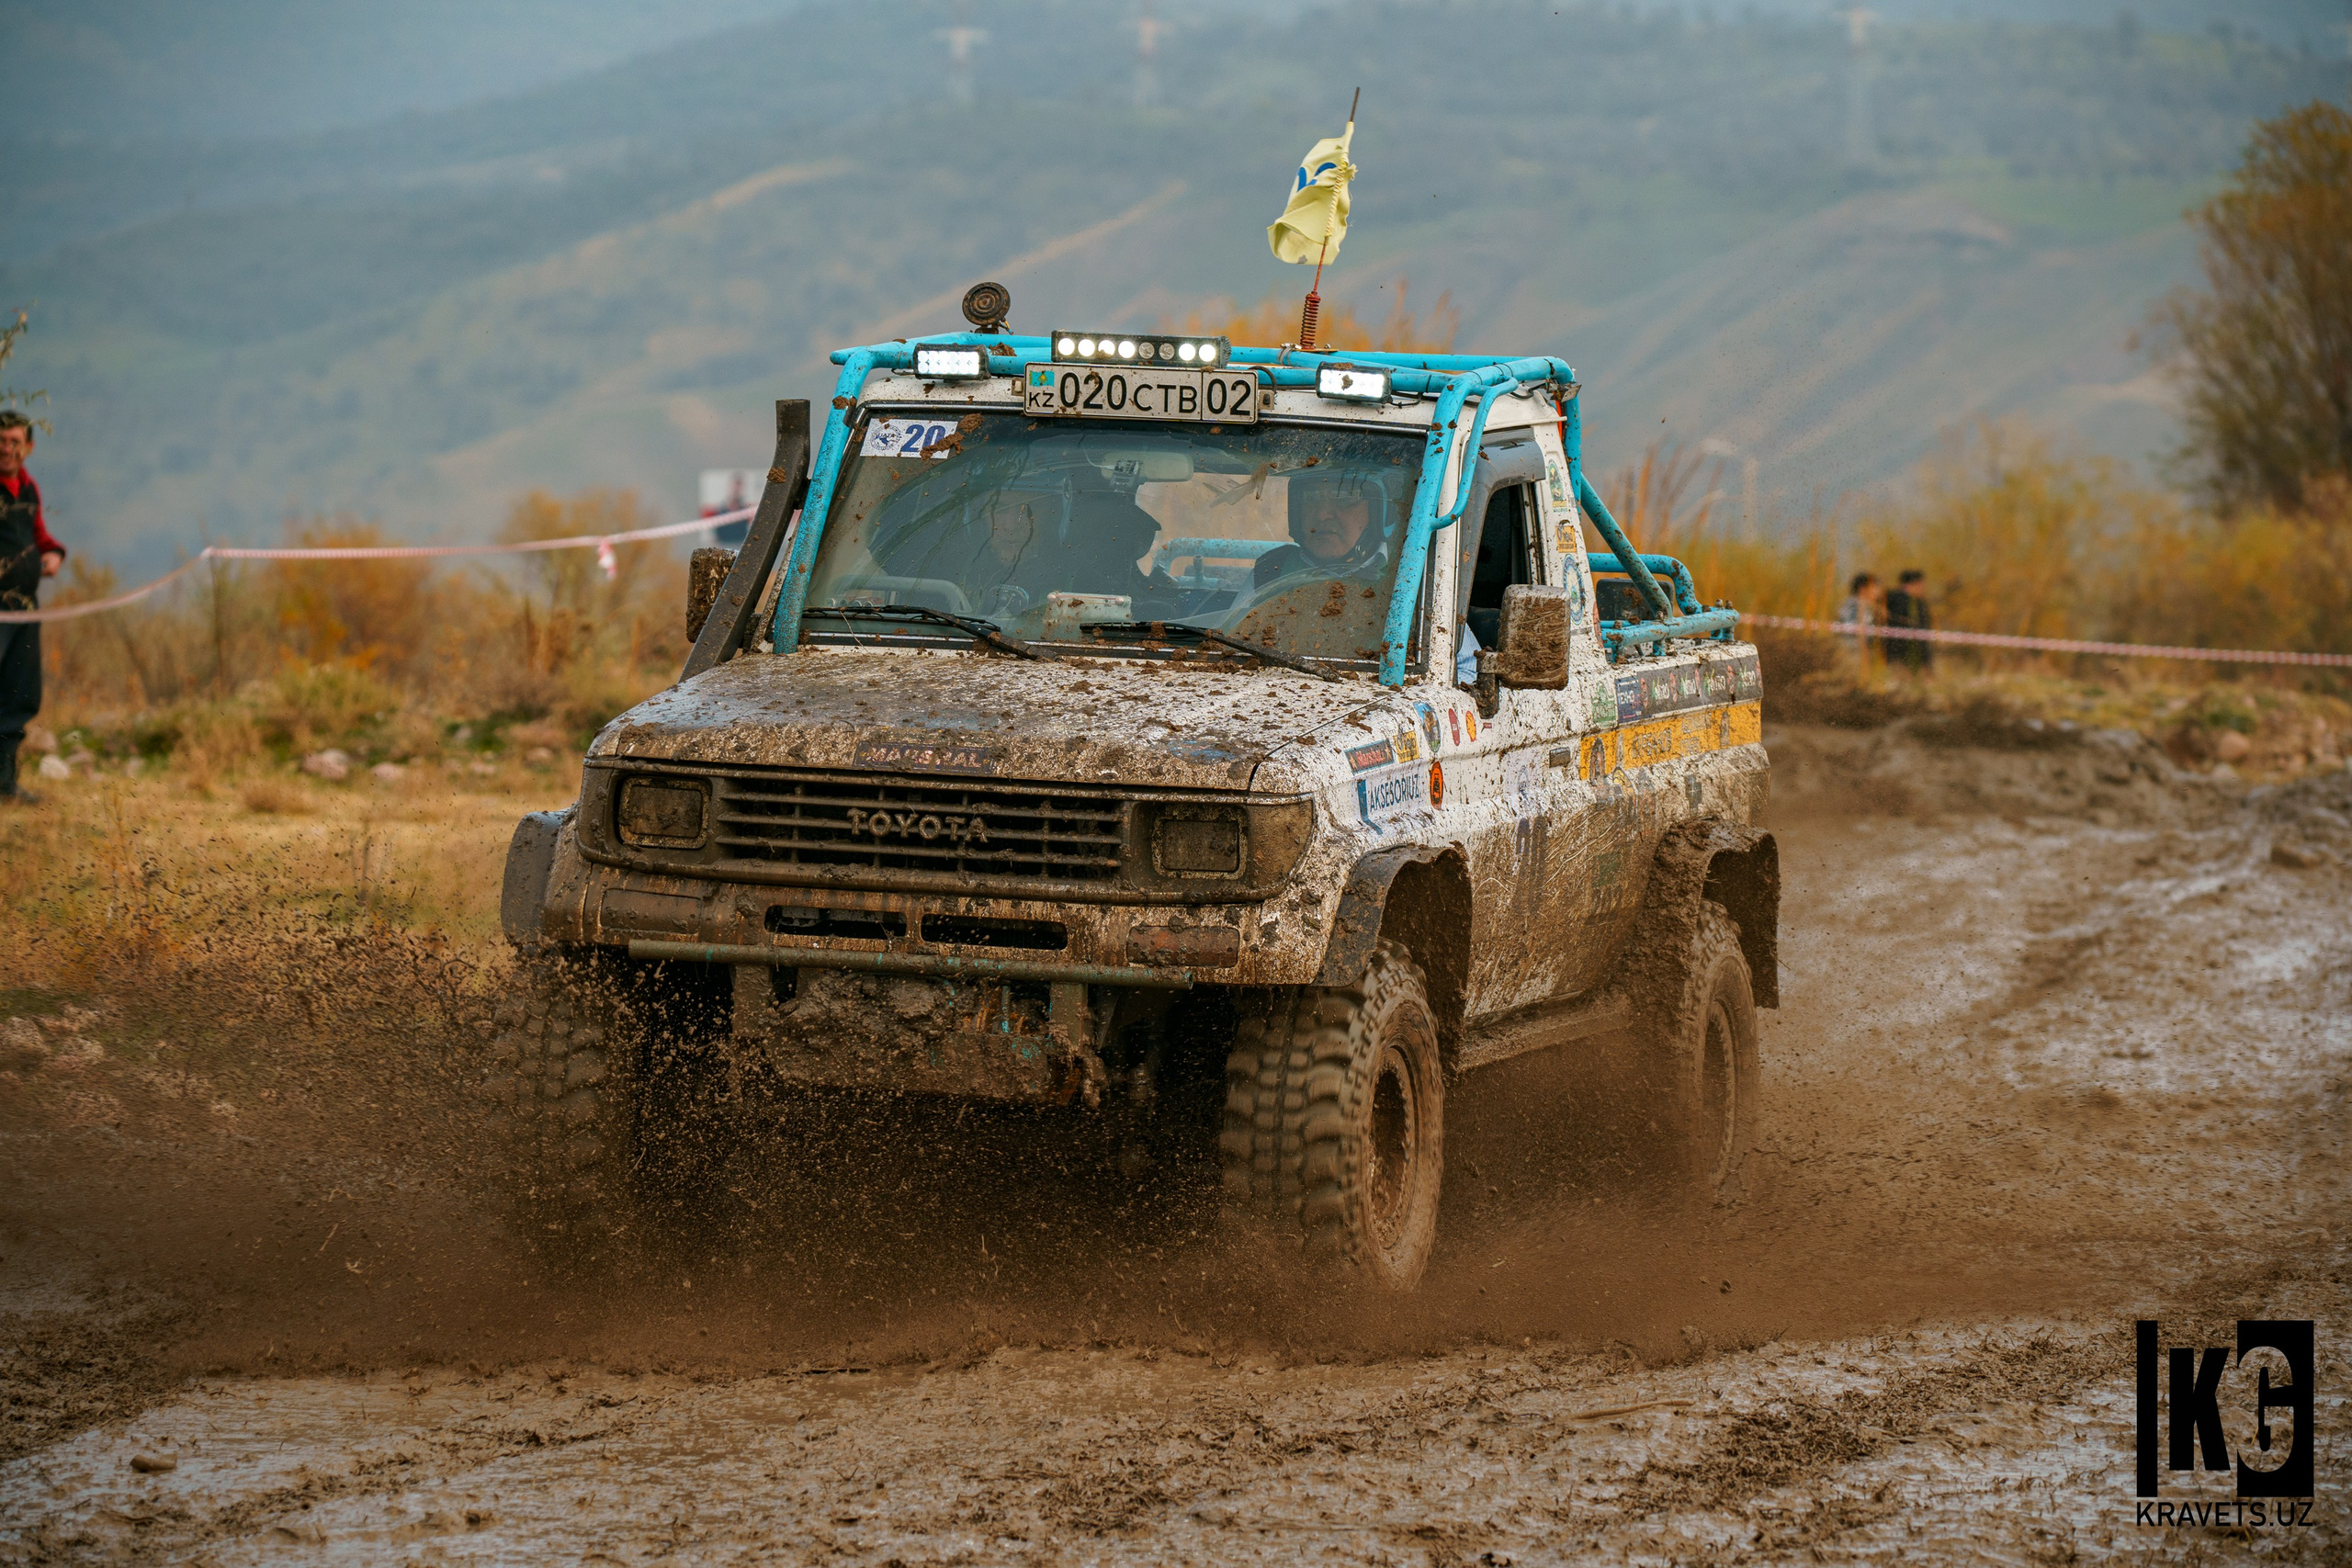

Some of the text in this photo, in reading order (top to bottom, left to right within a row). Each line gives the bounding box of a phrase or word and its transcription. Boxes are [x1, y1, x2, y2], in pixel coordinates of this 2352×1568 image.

[1028, 391, 1055, 408] KZ
[1206, 378, 1251, 416] 02
[899, 423, 947, 453] 20
[846, 807, 989, 843] TOYOTA
